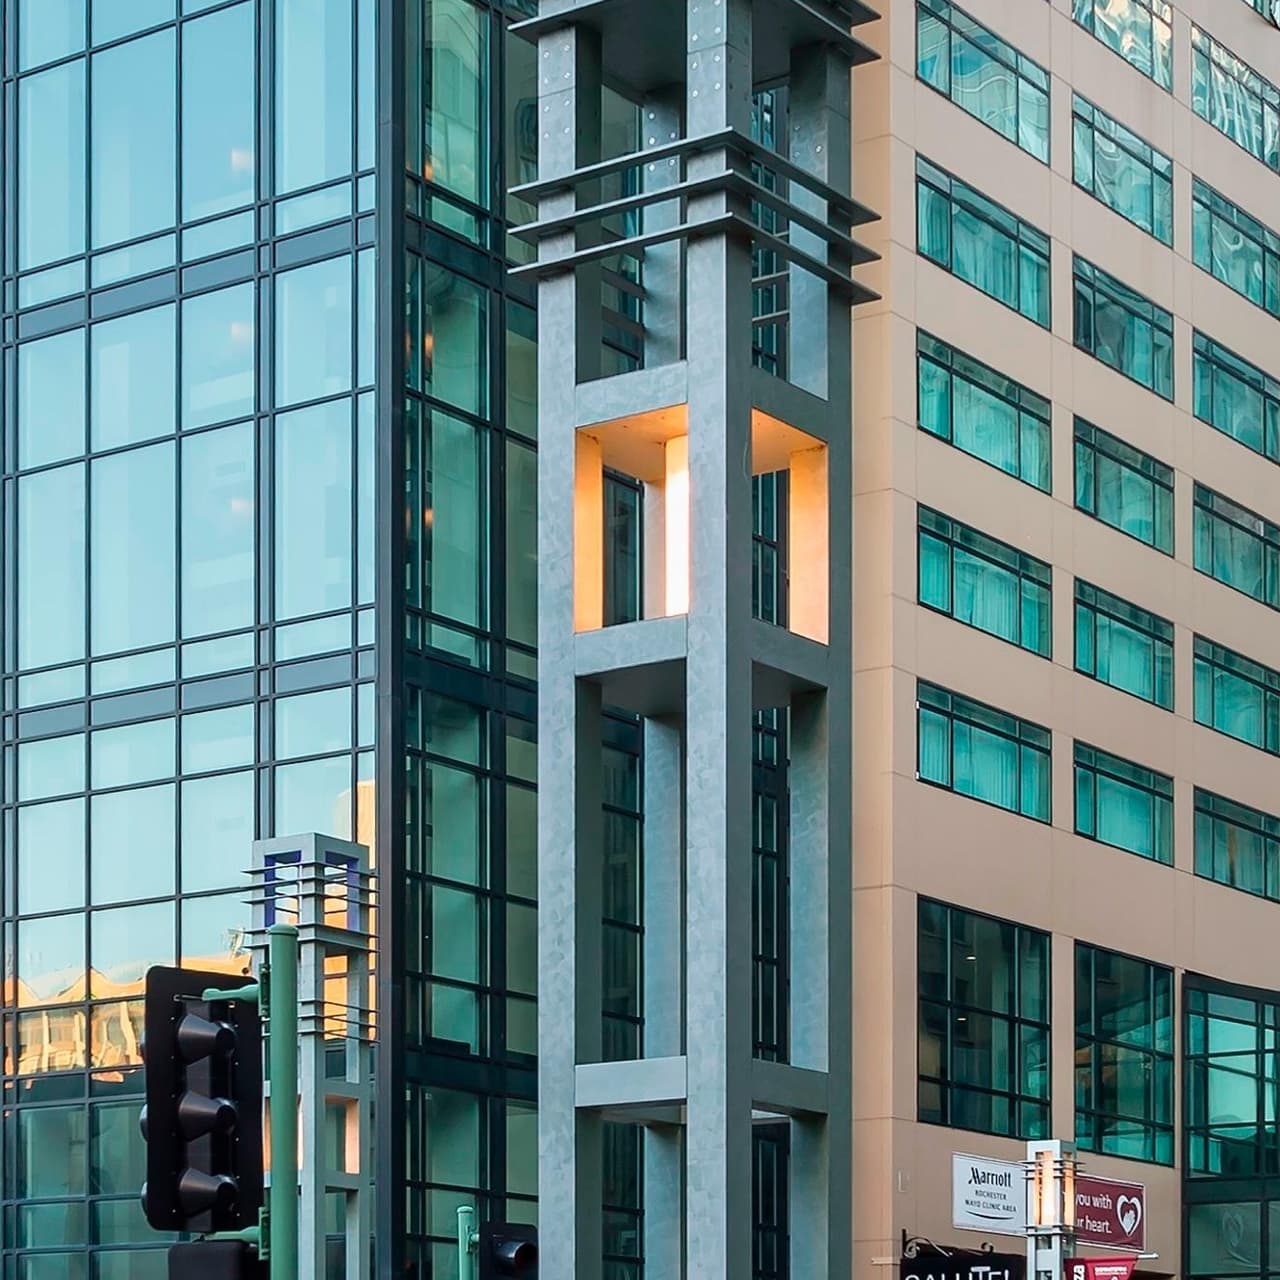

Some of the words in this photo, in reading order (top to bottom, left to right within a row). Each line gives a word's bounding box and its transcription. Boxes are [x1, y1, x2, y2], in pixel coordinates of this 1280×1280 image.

[968, 1166, 1012, 1188] Marriott
[974, 1189, 1007, 1201] ROCHESTER
[1092, 1193, 1113, 1210] with
[964, 1199, 981, 1209] MAYO
[982, 1200, 1001, 1211] CLINIC
[1002, 1202, 1017, 1213] AREA
[1085, 1216, 1113, 1234] heart.
